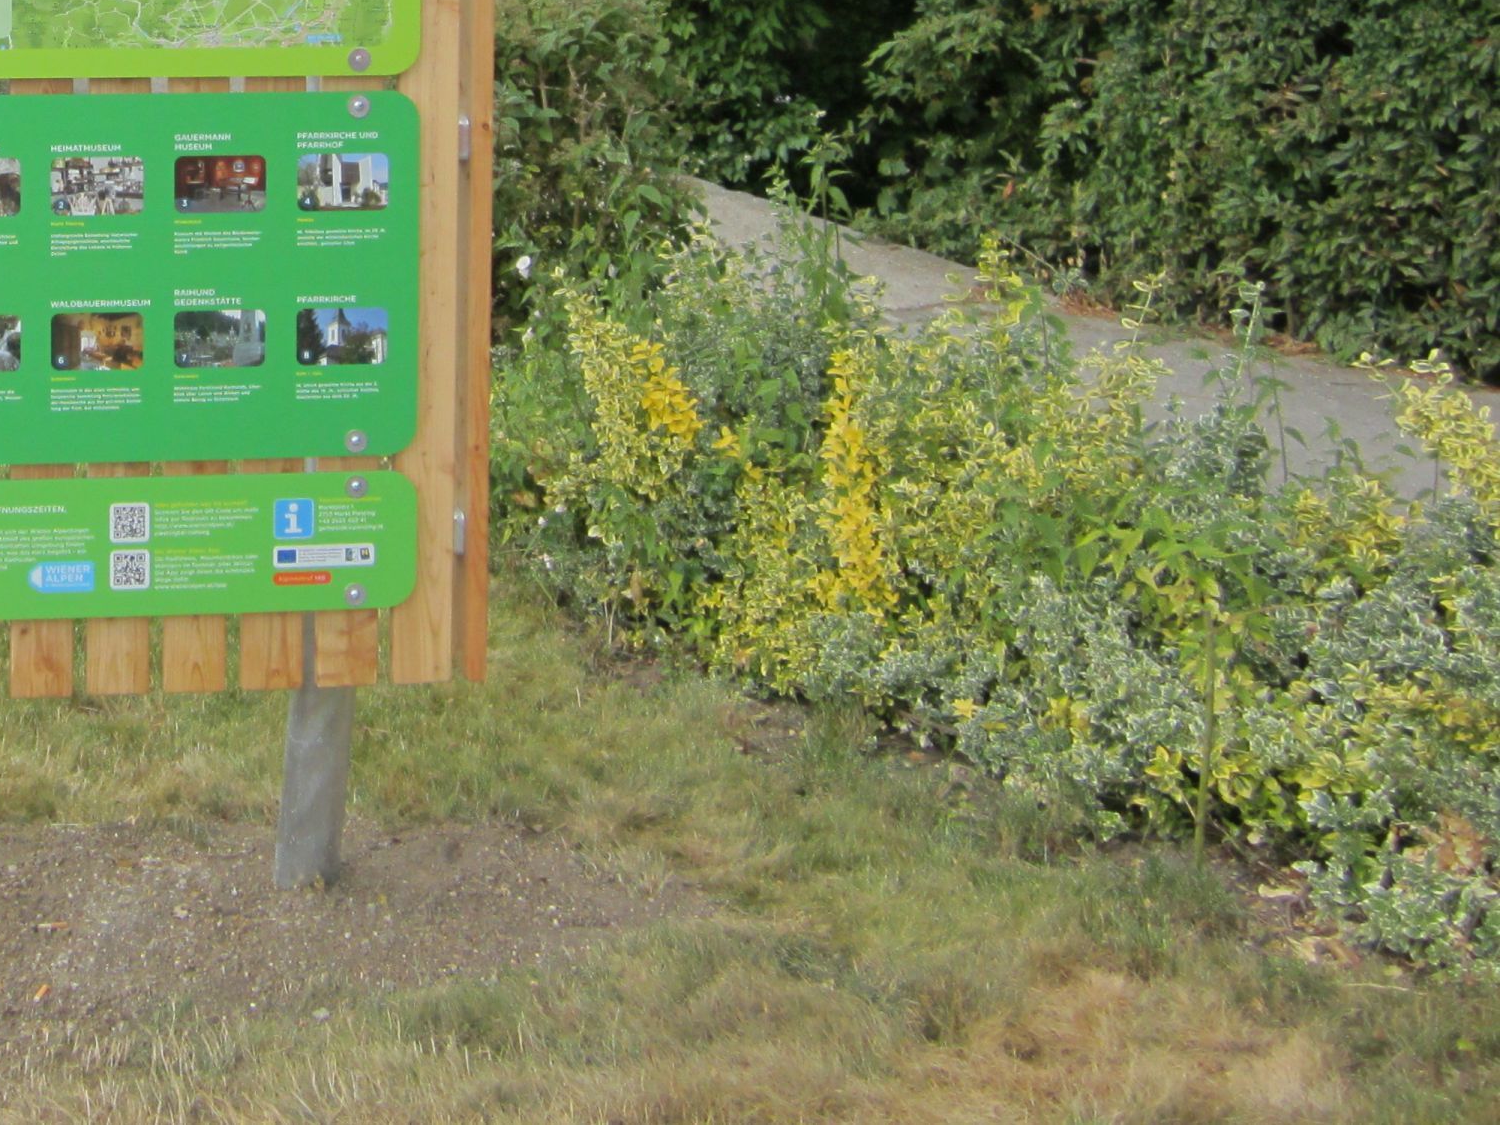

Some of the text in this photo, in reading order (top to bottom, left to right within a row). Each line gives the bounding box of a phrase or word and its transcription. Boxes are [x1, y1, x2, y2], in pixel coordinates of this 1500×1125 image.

[174, 133, 232, 142] GAUERMANN
[297, 131, 379, 140] PFARRKIRCHE UND
[50, 144, 122, 153] HEIMATMUSEUM
[174, 143, 213, 151] MUSEUM
[297, 141, 344, 149] PFARRHOF
[182, 199, 188, 207] 3
[174, 289, 215, 297] RAIMUND
[174, 296, 242, 306] GEDENKSTÄTTE
[296, 295, 357, 303] PFARRKIRCHE
[50, 299, 151, 308] WALDBAUERNMUSEUM
[303, 351, 310, 359] 8
[58, 356, 65, 364] 6
[45, 564, 91, 574] WIENER
[45, 574, 84, 583] ALPEN
